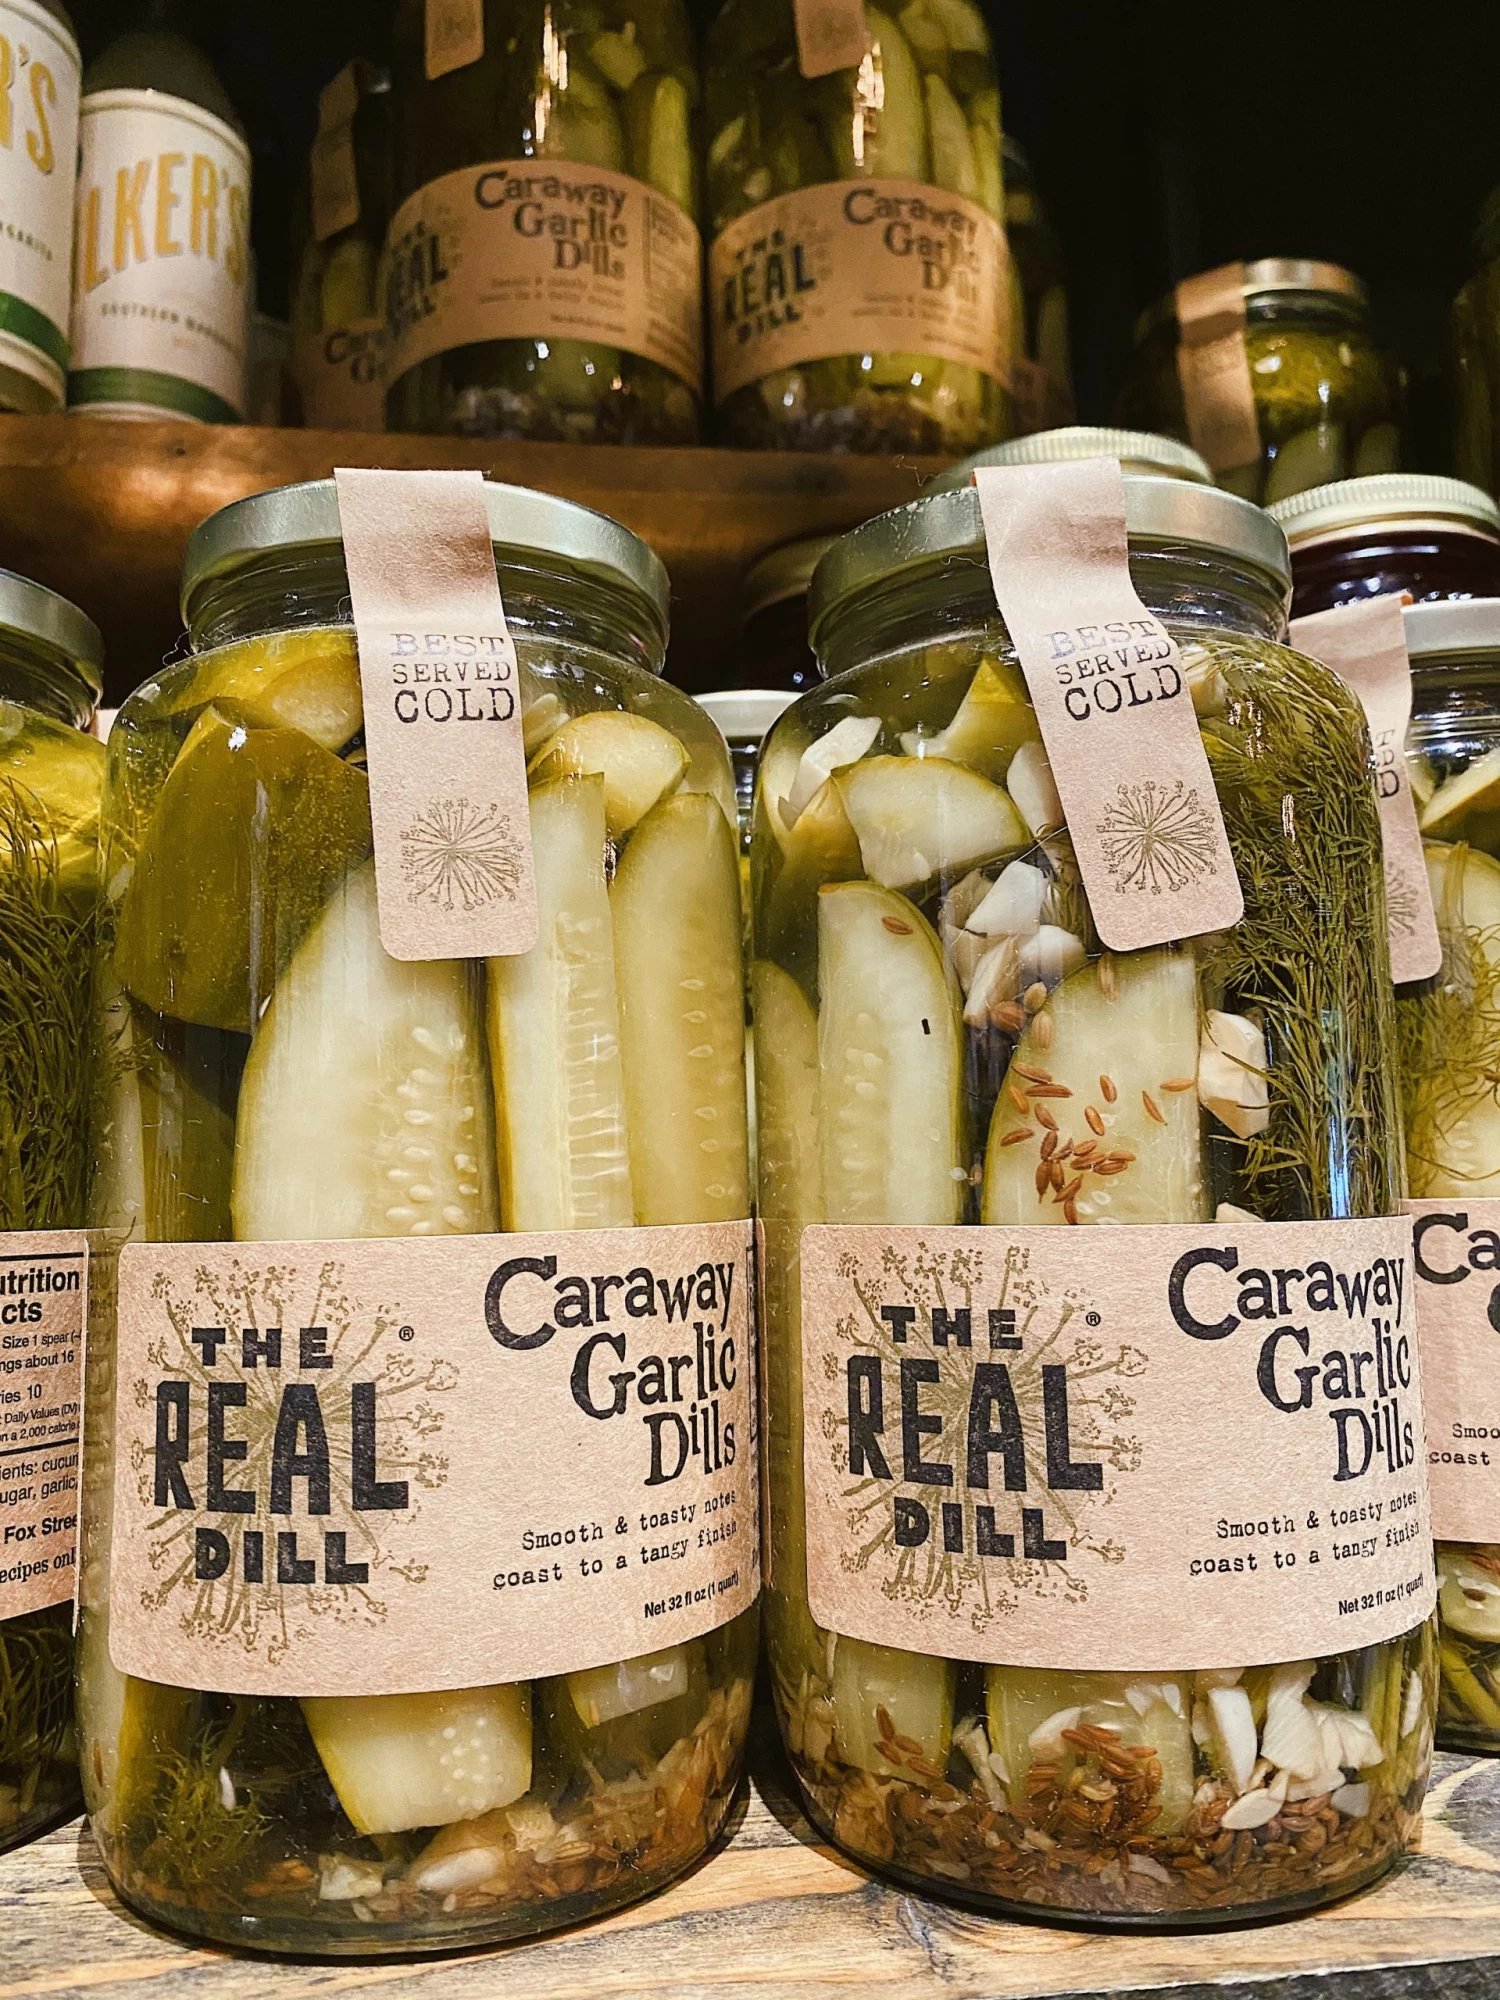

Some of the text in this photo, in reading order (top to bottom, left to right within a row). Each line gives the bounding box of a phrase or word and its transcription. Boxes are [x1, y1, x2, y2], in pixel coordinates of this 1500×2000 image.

[475, 170, 627, 217] Caraway
[390, 633, 504, 657] BEST
[1044, 621, 1158, 659] BEST
[1056, 640, 1172, 684] SERVED
[393, 661, 511, 684] SERVED
[1065, 664, 1181, 721] COLD
[394, 687, 515, 723] COLD
[2, 1298, 42, 1325] cts
[484, 1255, 735, 1351] Caraway
[1168, 1246, 1405, 1341] Caraway
[2, 1335, 30, 1349] Size
[33, 1334, 38, 1346] 1
[41, 1332, 69, 1347] spear
[192, 1327, 334, 1369] THE
[881, 1305, 1024, 1350] THE
[25, 1352, 58, 1368] about
[61, 1350, 74, 1363] 16
[570, 1321, 737, 1420] Garlic
[1256, 1318, 1411, 1413] Garlic
[27, 1384, 42, 1400] 10
[4, 1410, 29, 1424] Daily
[30, 1406, 60, 1420] Values
[20, 1425, 47, 1440] 2,000
[48, 1421, 76, 1434] calorie
[847, 1354, 1104, 1492] REAL
[154, 1380, 409, 1515] REAL
[643, 1400, 736, 1486] Dills
[1329, 1398, 1415, 1482] Dills
[1428, 1451, 1490, 1466] coast
[4, 1525, 37, 1545] Fox
[522, 1490, 736, 1551] Smooth & toasty notes
[893, 1497, 1067, 1561] DILL
[1217, 1491, 1417, 1539] Smooth & toasty notes
[195, 1527, 369, 1584] DILL
[492, 1518, 737, 1590] coast to a tangy finish
[1190, 1519, 1420, 1576] coast to a tangy finish
[644, 1599, 666, 1618] Net
[668, 1595, 683, 1611] 32
[685, 1591, 692, 1606] fl
[694, 1588, 706, 1604] oz
[708, 1581, 715, 1600] (1
[1338, 1598, 1359, 1616] Net
[1361, 1594, 1375, 1610] 32
[1376, 1591, 1383, 1606] fl
[1385, 1589, 1396, 1602] oz
[1397, 1582, 1404, 1601] (1
